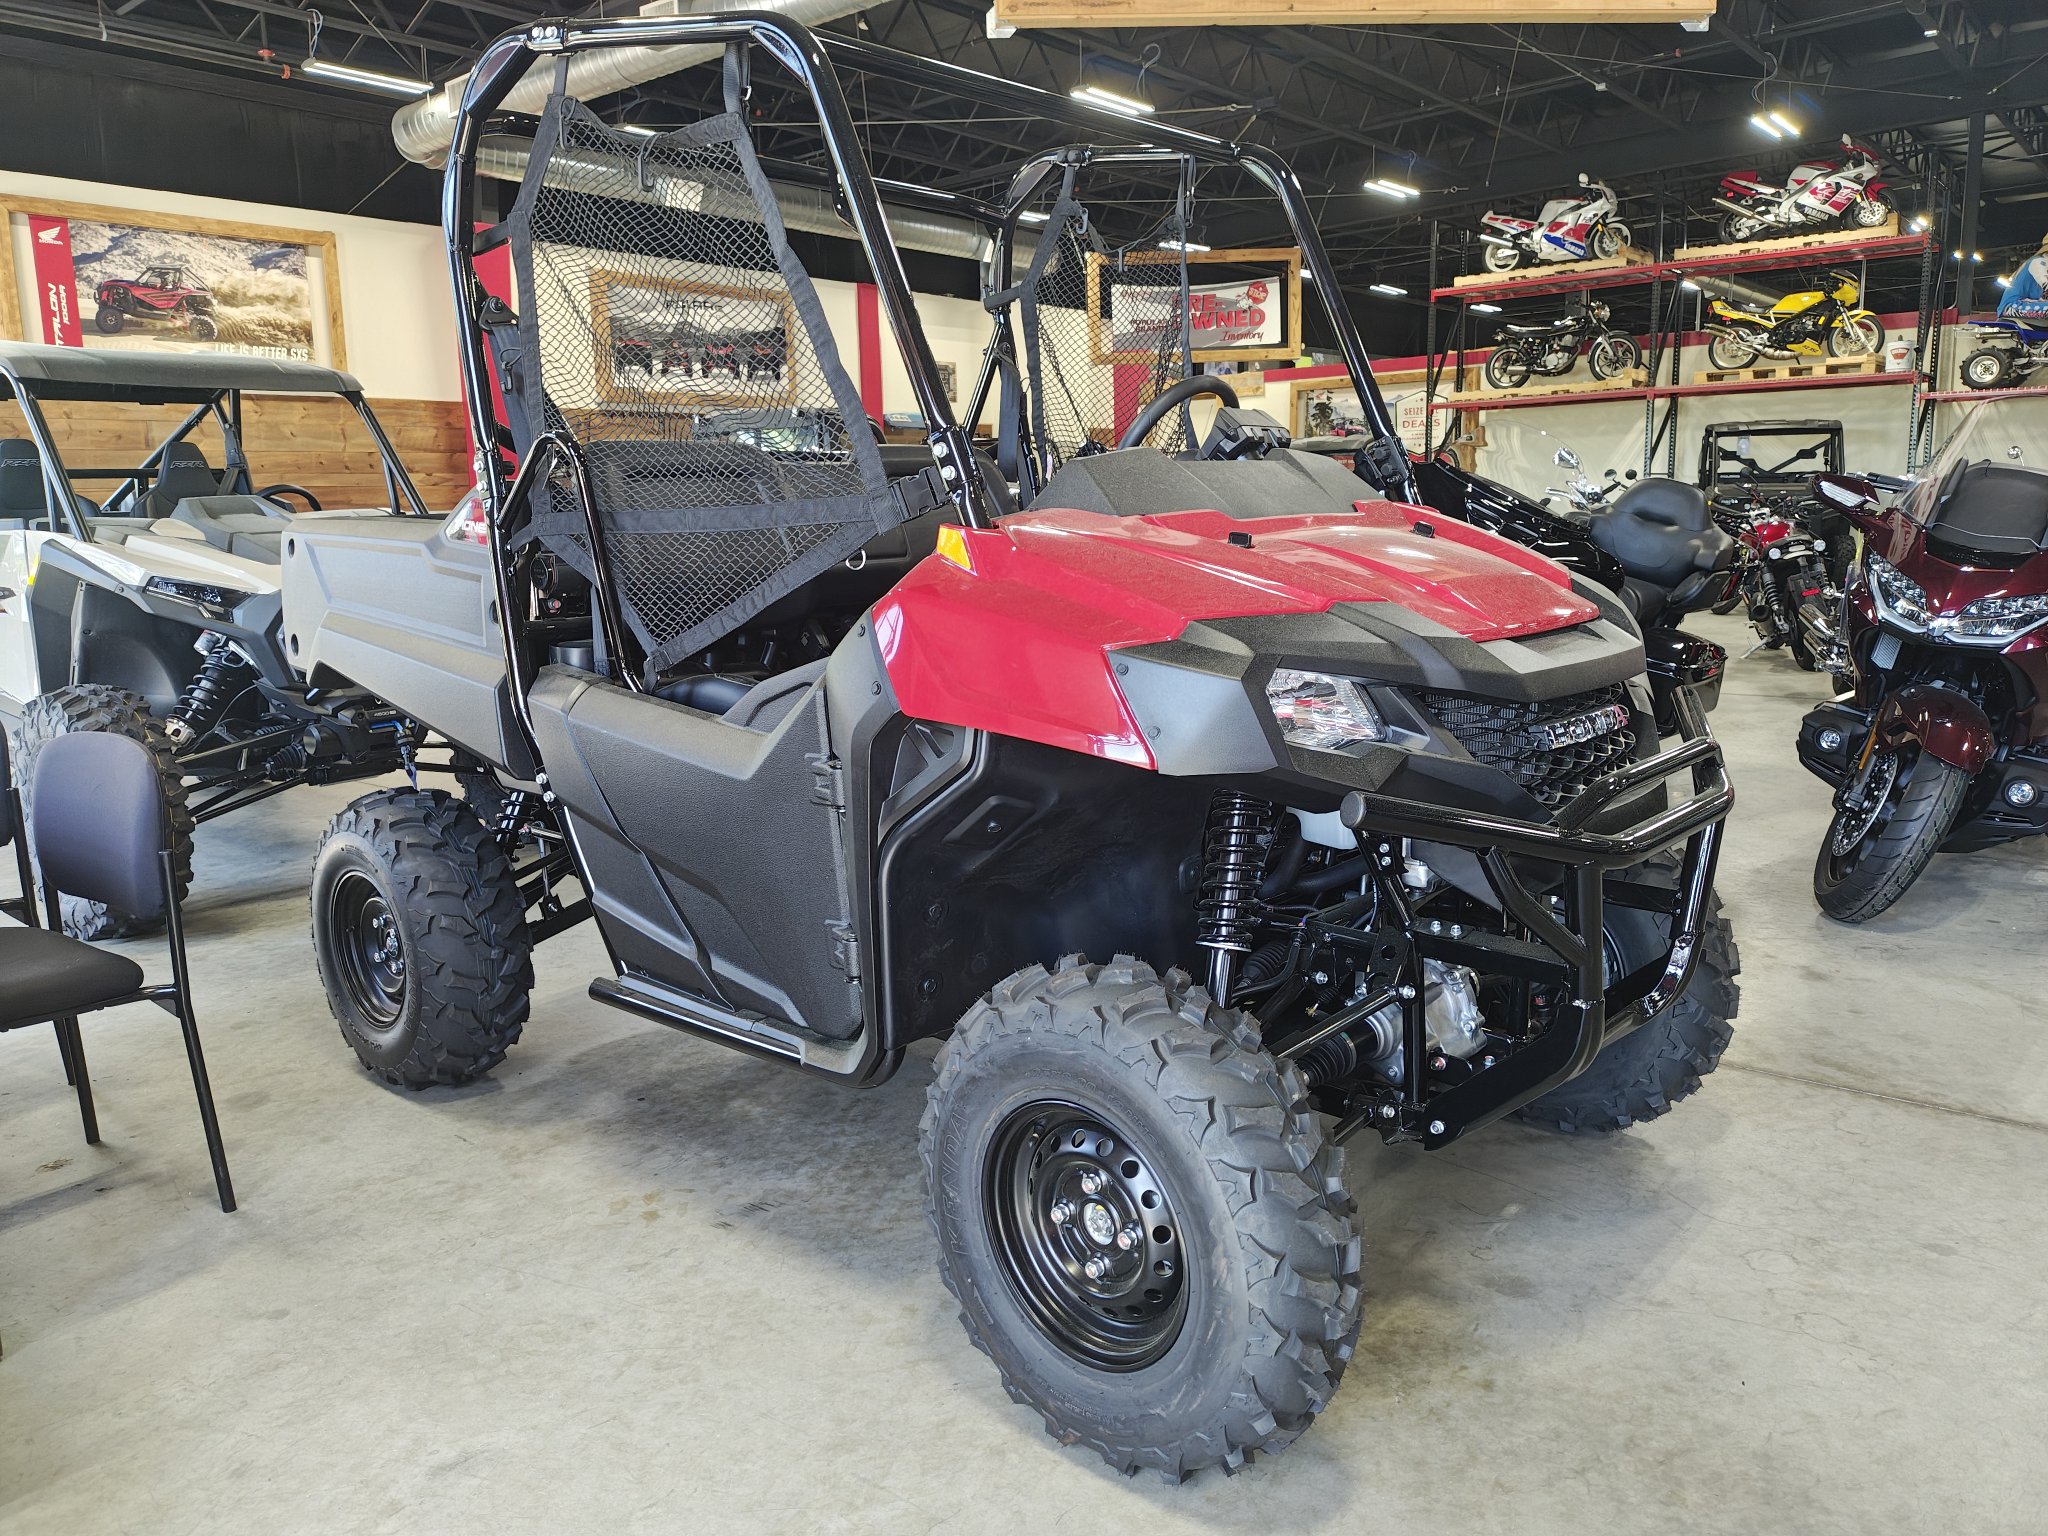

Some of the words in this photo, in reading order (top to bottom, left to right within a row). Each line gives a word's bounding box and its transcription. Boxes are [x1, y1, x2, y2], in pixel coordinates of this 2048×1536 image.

[38, 238, 63, 246] HONDA
[58, 284, 70, 325] 1000R
[47, 282, 65, 346] TALON
[1219, 331, 1264, 342] Inventory
[240, 345, 249, 355] IS
[252, 345, 288, 360] BETTER
[290, 348, 309, 362] SXS
[1404, 407, 1424, 416] SEIZE
[1402, 419, 1441, 429] DEAS
[170, 460, 205, 469] RZR
[941, 1111, 969, 1256] KENDA
